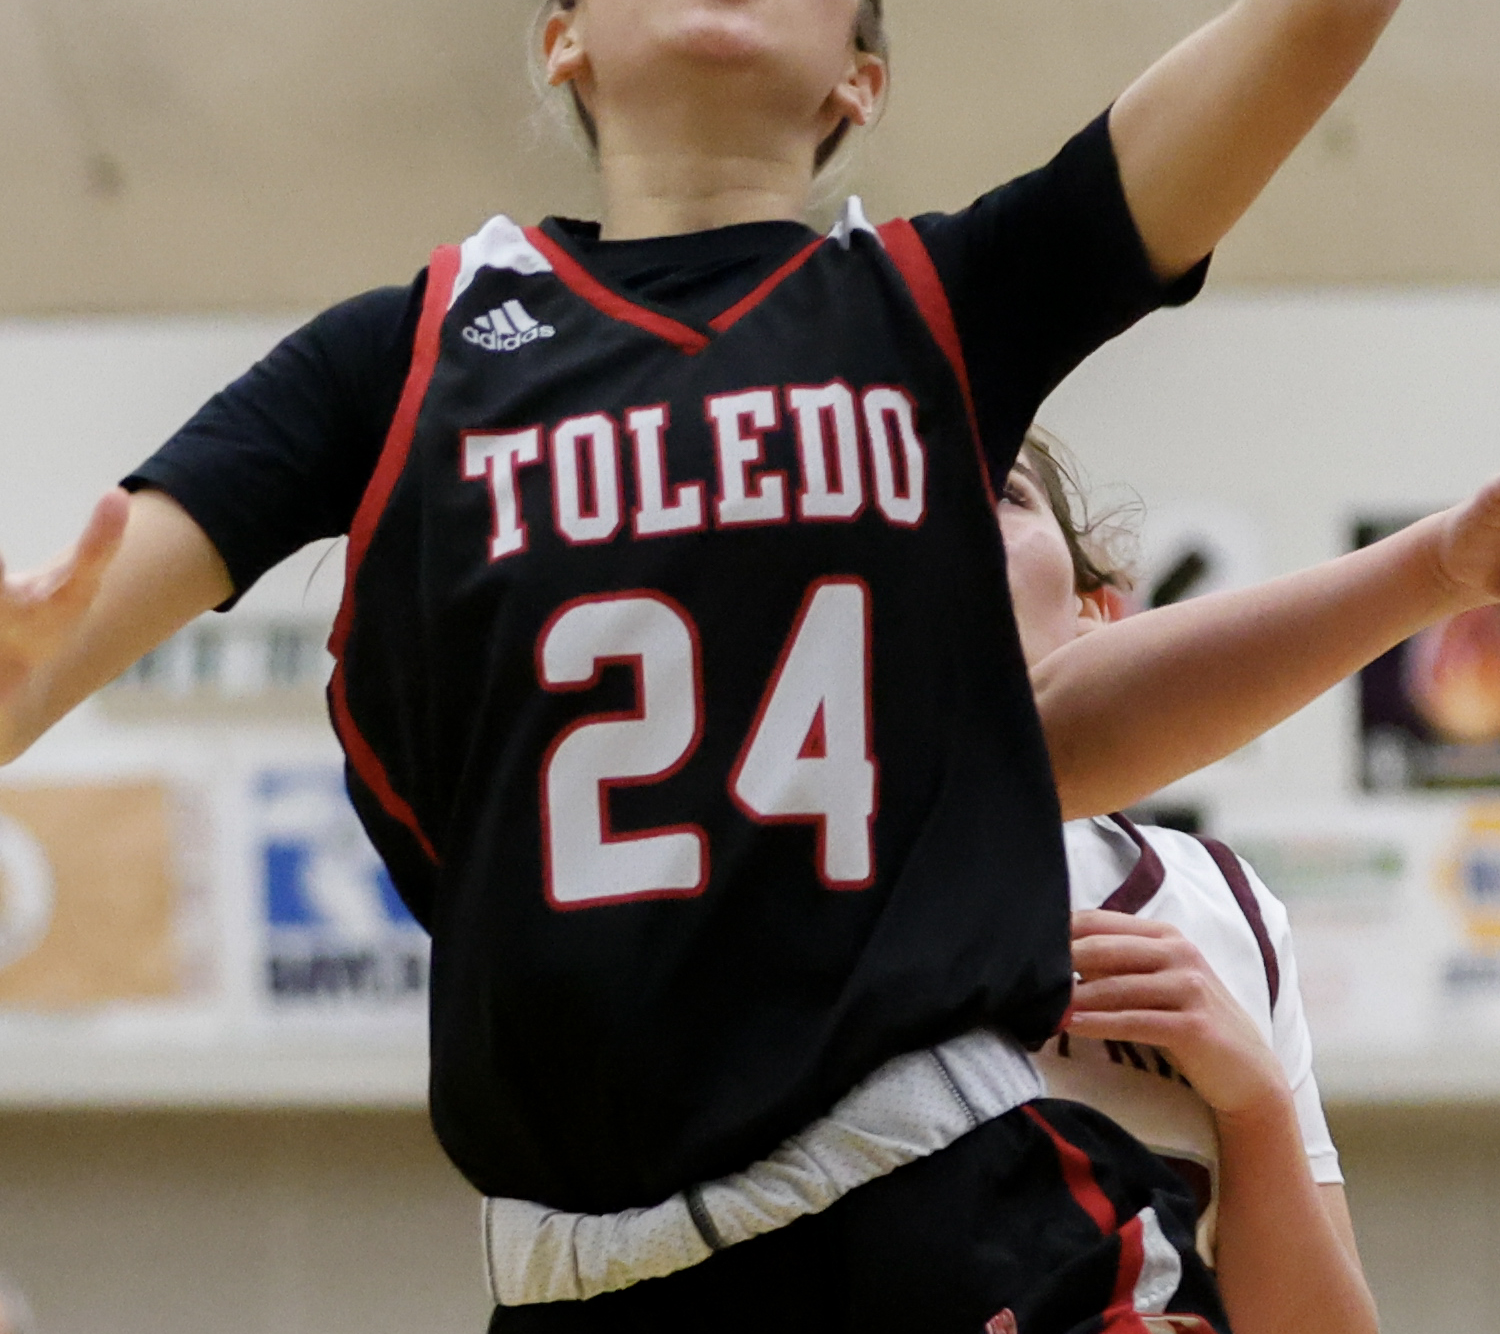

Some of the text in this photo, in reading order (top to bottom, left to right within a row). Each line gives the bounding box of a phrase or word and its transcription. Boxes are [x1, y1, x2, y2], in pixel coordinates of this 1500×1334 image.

[461, 323, 557, 352] adidas
[461, 378, 926, 562] TOLEDO
[535, 574, 880, 911] 24
